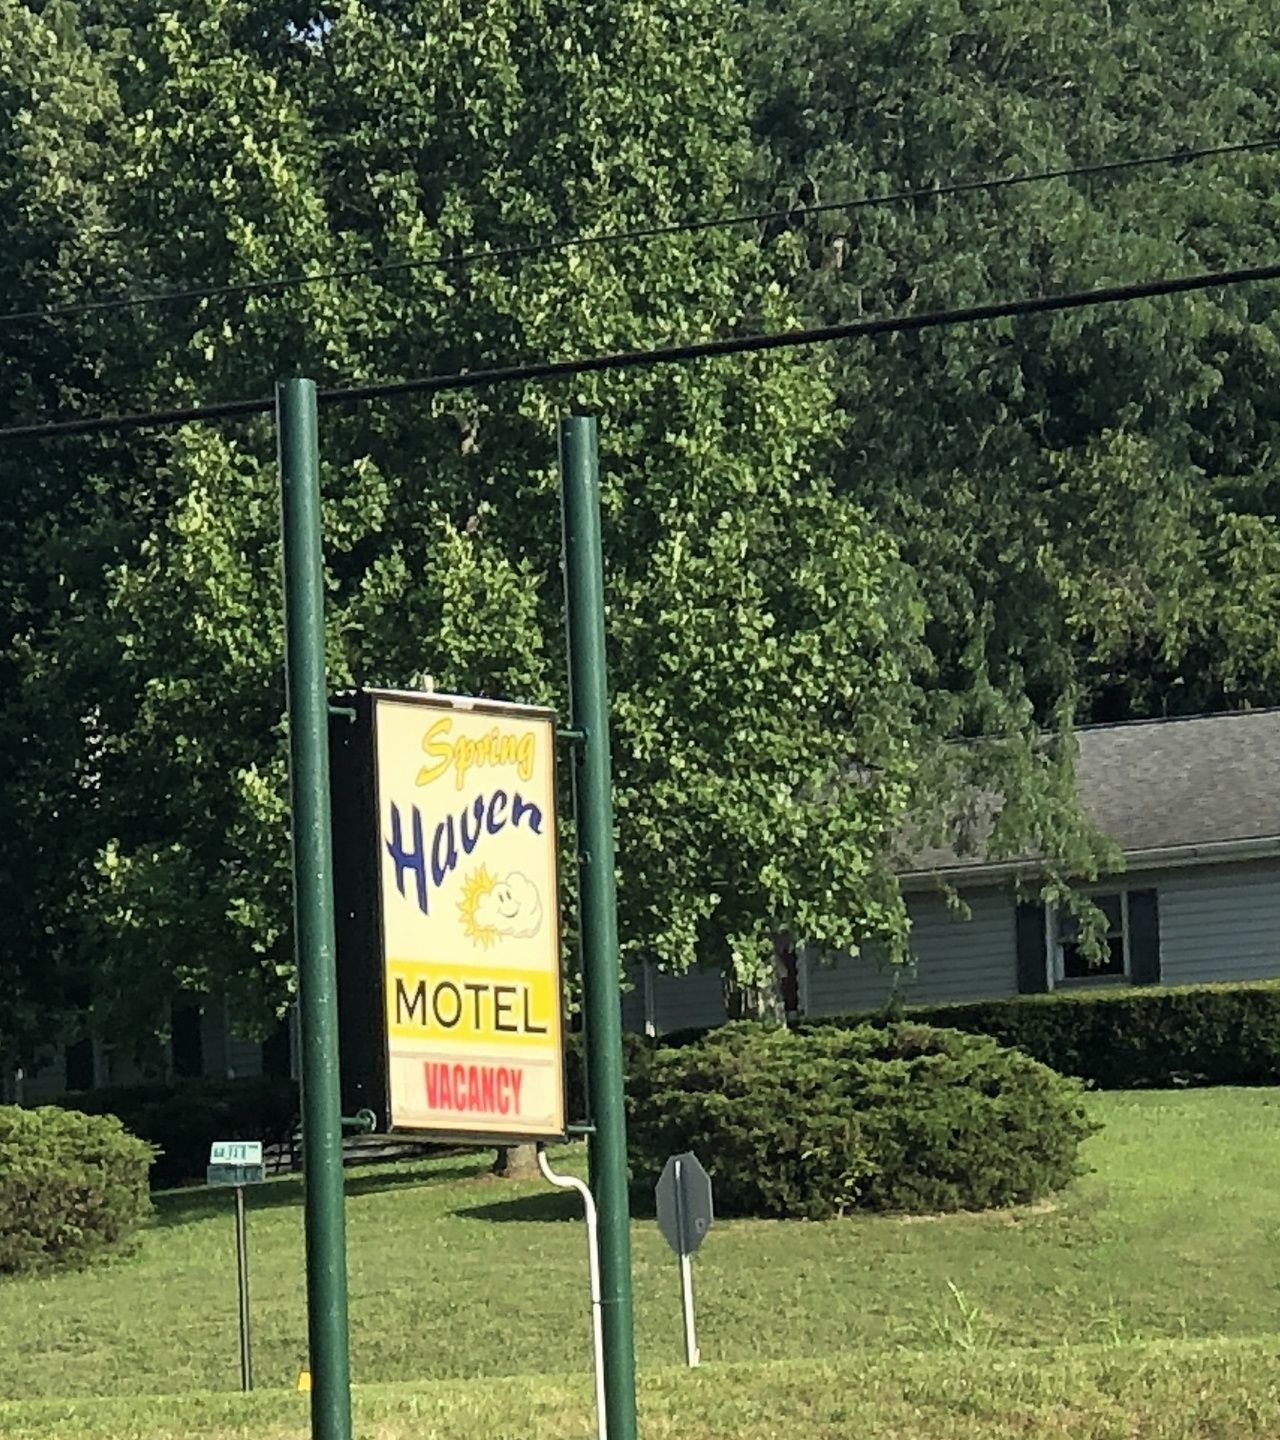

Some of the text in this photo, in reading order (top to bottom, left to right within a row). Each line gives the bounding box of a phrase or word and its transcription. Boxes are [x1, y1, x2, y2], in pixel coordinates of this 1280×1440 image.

[416, 717, 535, 789] Spring
[386, 790, 542, 915] Haven
[395, 978, 547, 1034] MOTEL
[425, 1062, 523, 1115] VACANCY
